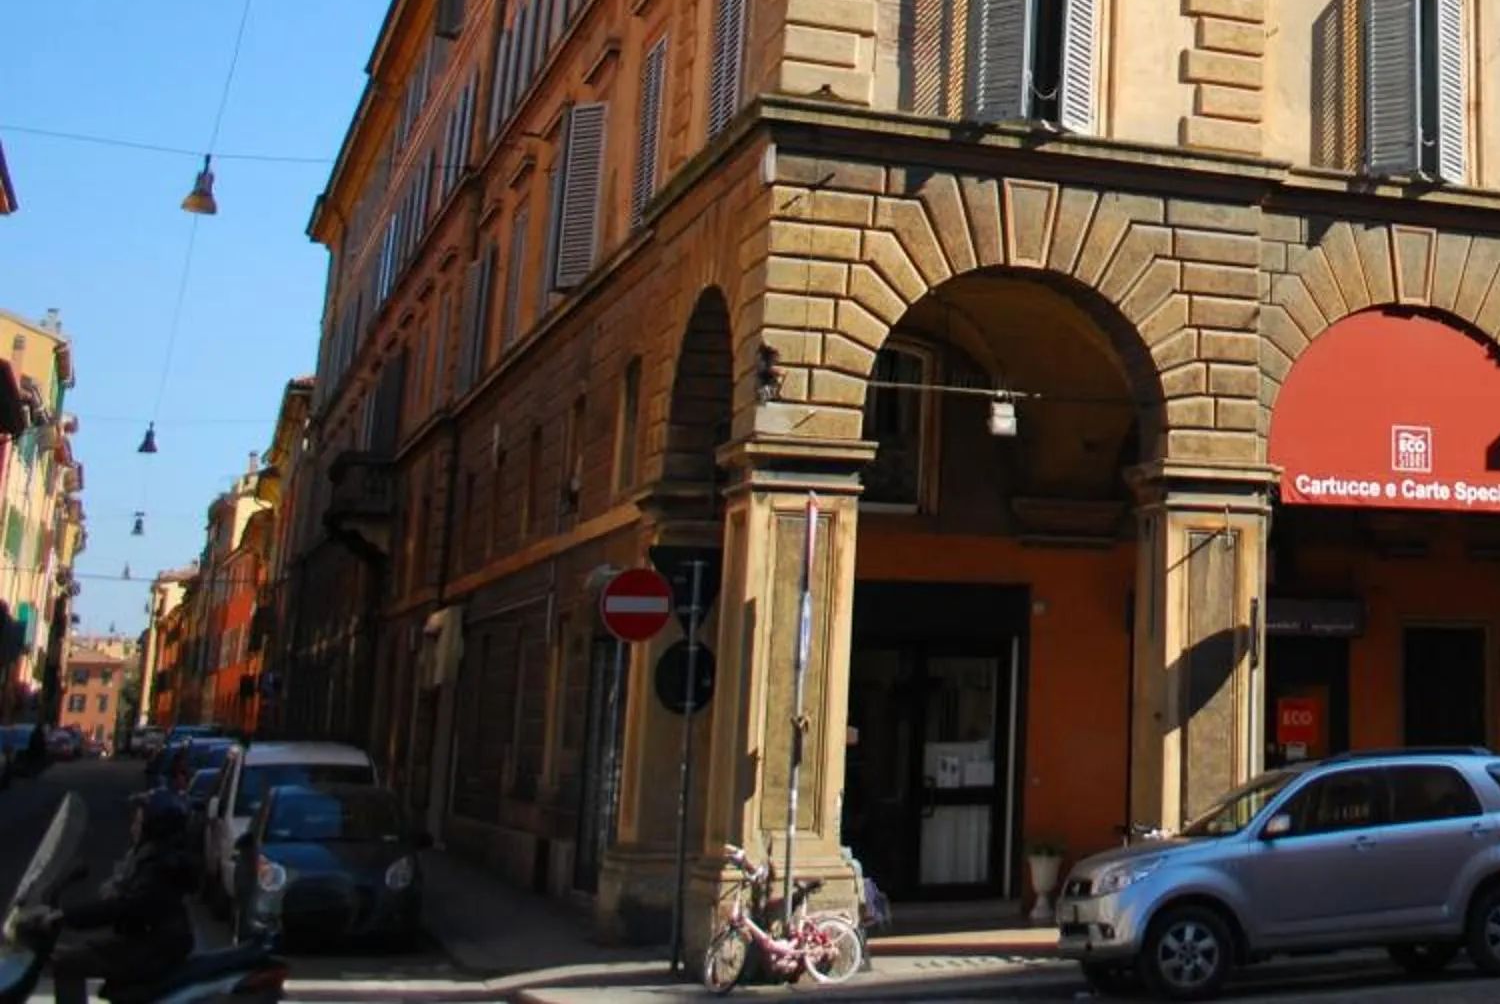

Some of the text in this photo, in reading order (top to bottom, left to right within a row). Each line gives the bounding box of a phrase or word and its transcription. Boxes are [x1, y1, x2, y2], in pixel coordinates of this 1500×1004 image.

[1399, 439, 1426, 453] ECO
[1295, 473, 1381, 498] Cartucce
[1385, 482, 1398, 499] e
[1401, 478, 1450, 501] Carte
[1282, 709, 1313, 726] ECO
